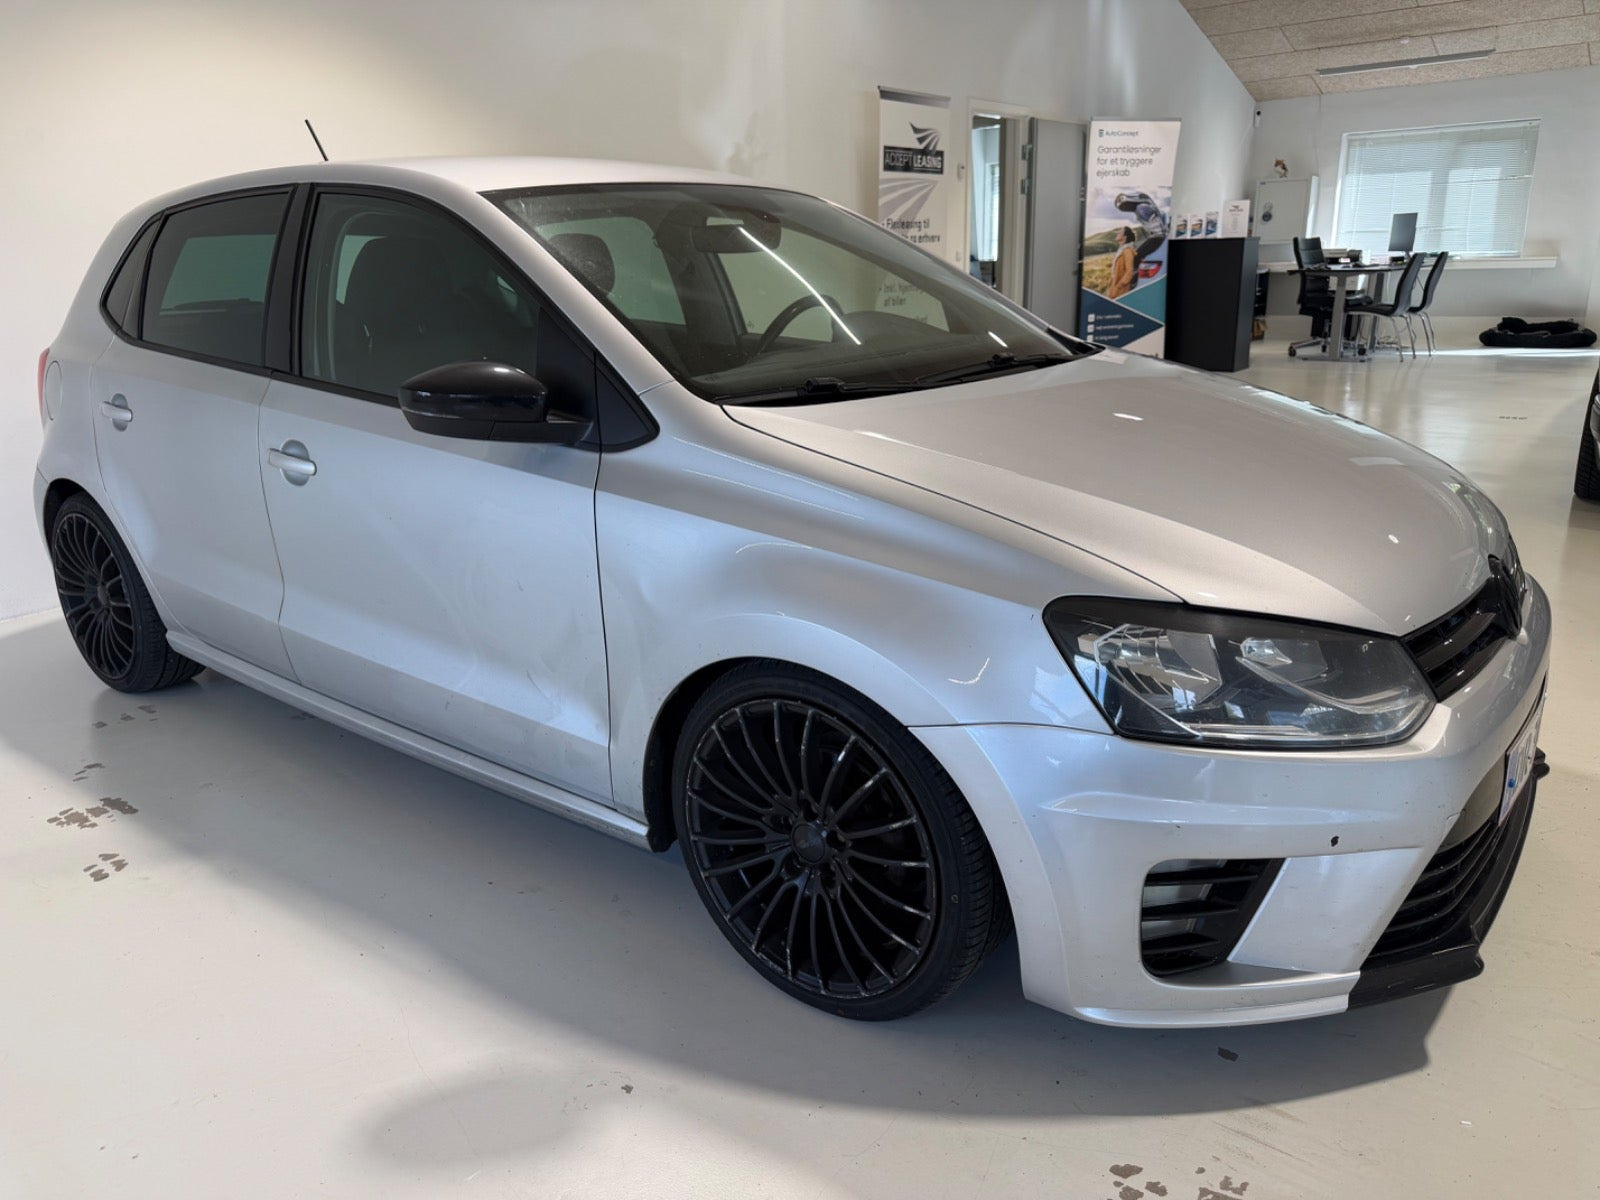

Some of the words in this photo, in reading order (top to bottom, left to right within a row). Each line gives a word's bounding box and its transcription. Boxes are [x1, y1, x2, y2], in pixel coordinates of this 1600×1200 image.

[913, 154, 942, 169] LEASING
[1097, 157, 1107, 166] for
[1110, 157, 1118, 166] et
[1120, 157, 1153, 168] tryggere
[1096, 168, 1130, 179] ejerskab
